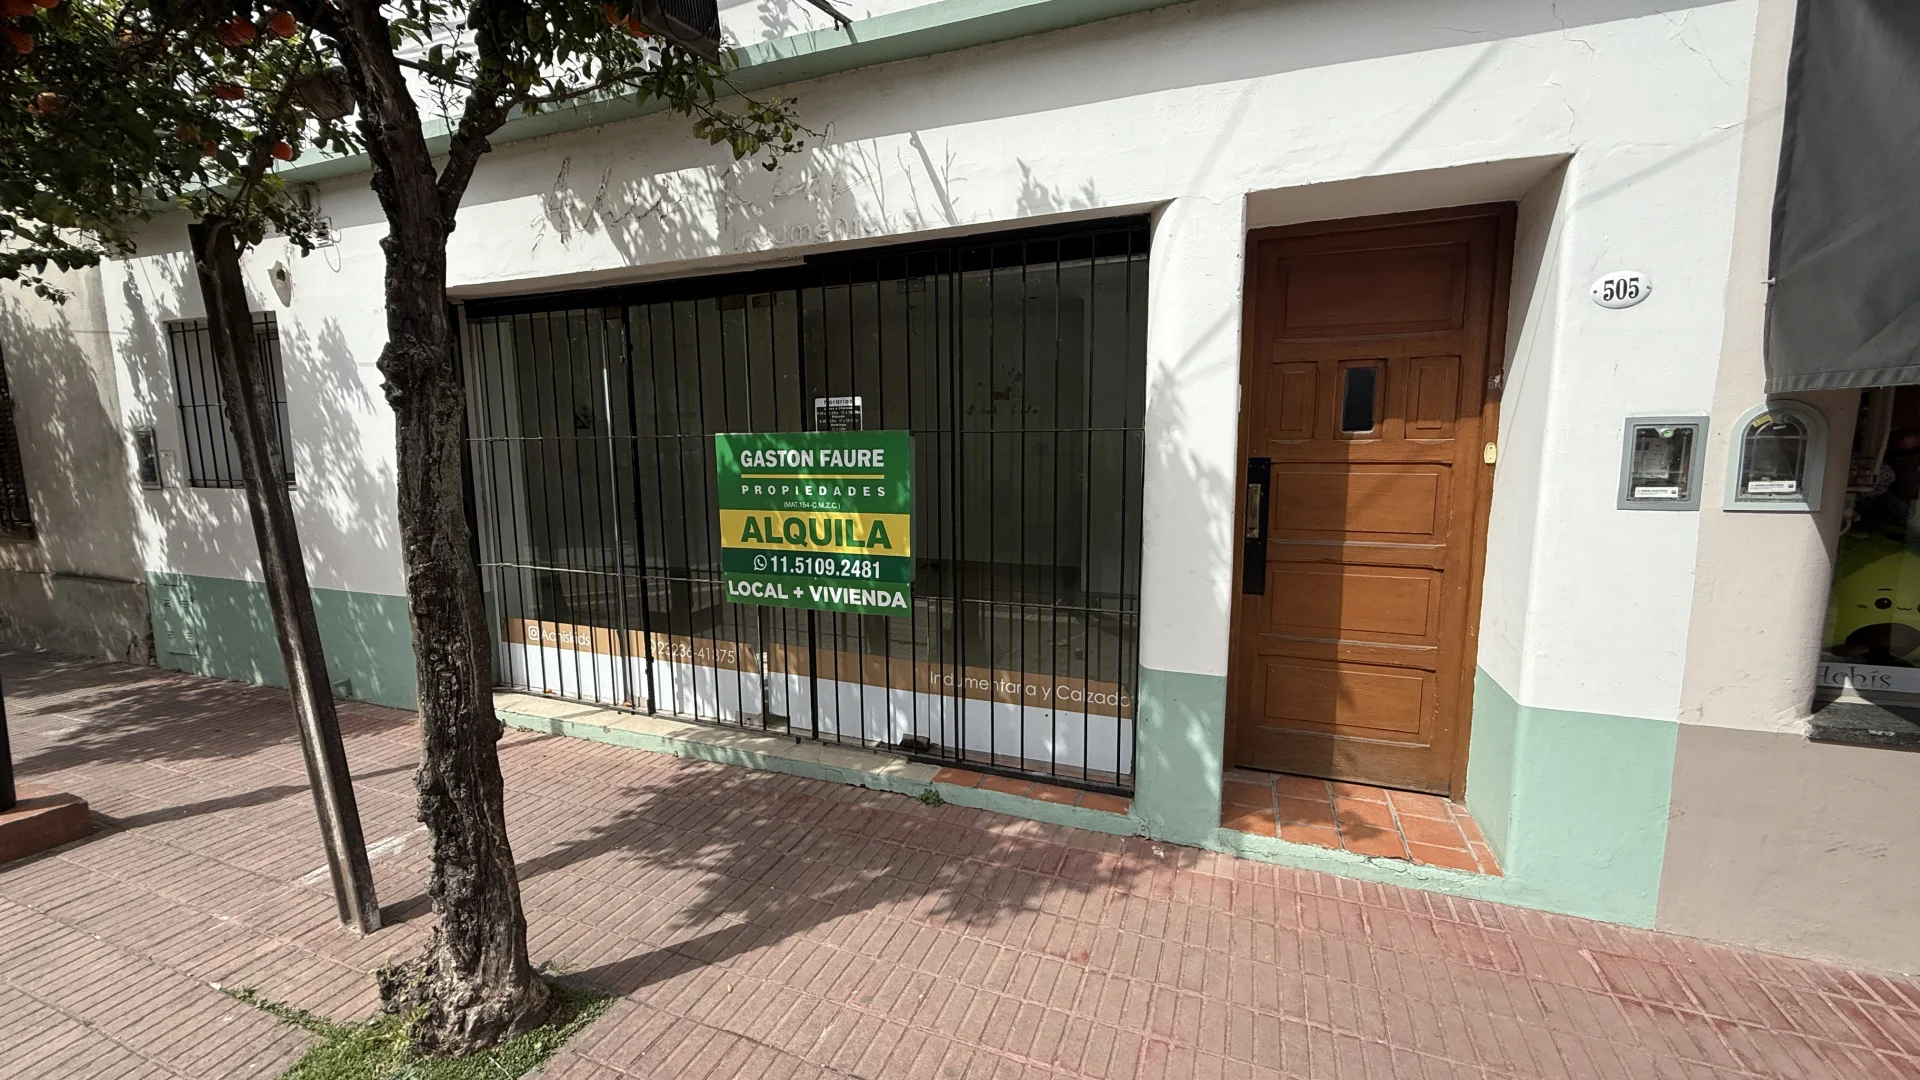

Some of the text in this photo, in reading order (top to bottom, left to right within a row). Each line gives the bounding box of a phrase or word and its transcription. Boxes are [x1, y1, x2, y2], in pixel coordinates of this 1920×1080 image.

[1602, 277, 1640, 301] 505
[740, 449, 885, 468] GASTON FAURE
[741, 484, 886, 497] PROPIEDADES
[740, 516, 893, 550] ALQUILA
[771, 555, 881, 579] 11.5109.2481
[728, 579, 908, 609] LOCAL + VIVIENDA
[930, 670, 1037, 697] Indumentara
[1041, 686, 1052, 701] y
